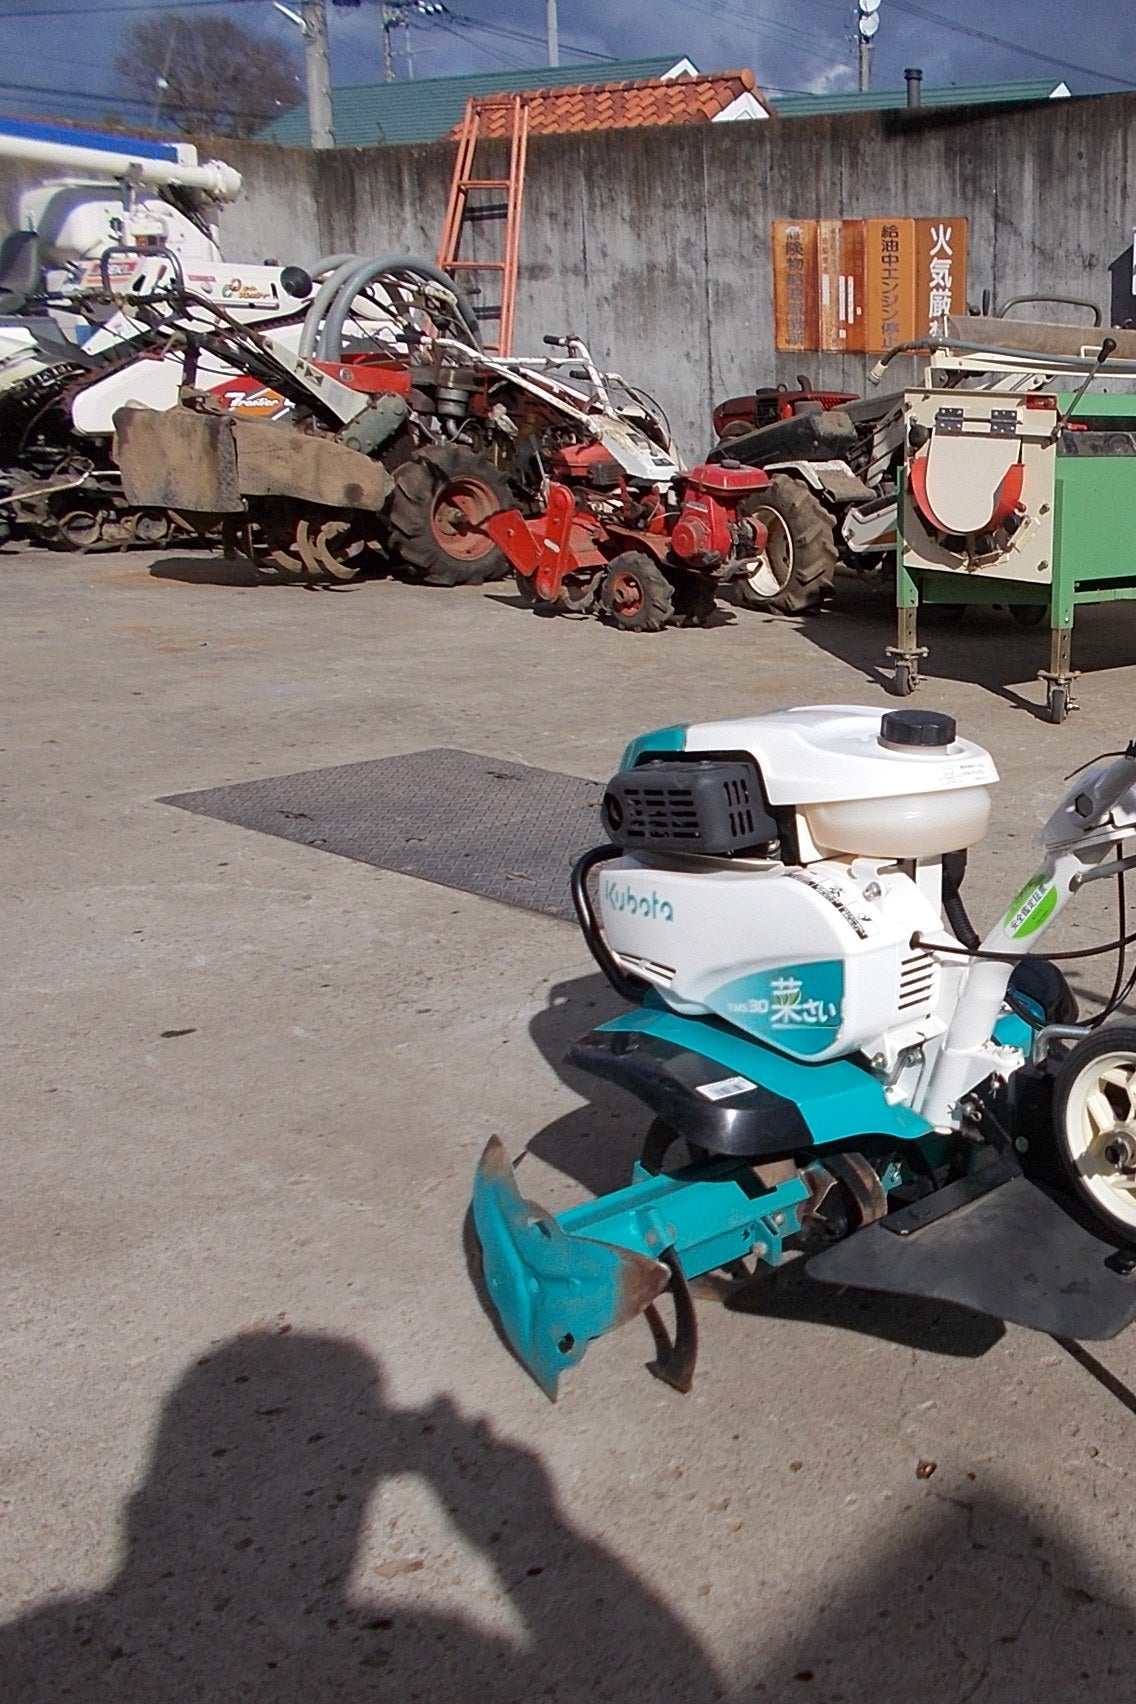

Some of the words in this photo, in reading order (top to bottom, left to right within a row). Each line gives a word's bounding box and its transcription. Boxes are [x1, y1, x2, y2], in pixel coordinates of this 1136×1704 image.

[881, 225, 899, 348] 給油中エンジン停止
[605, 880, 674, 922] Kubota
